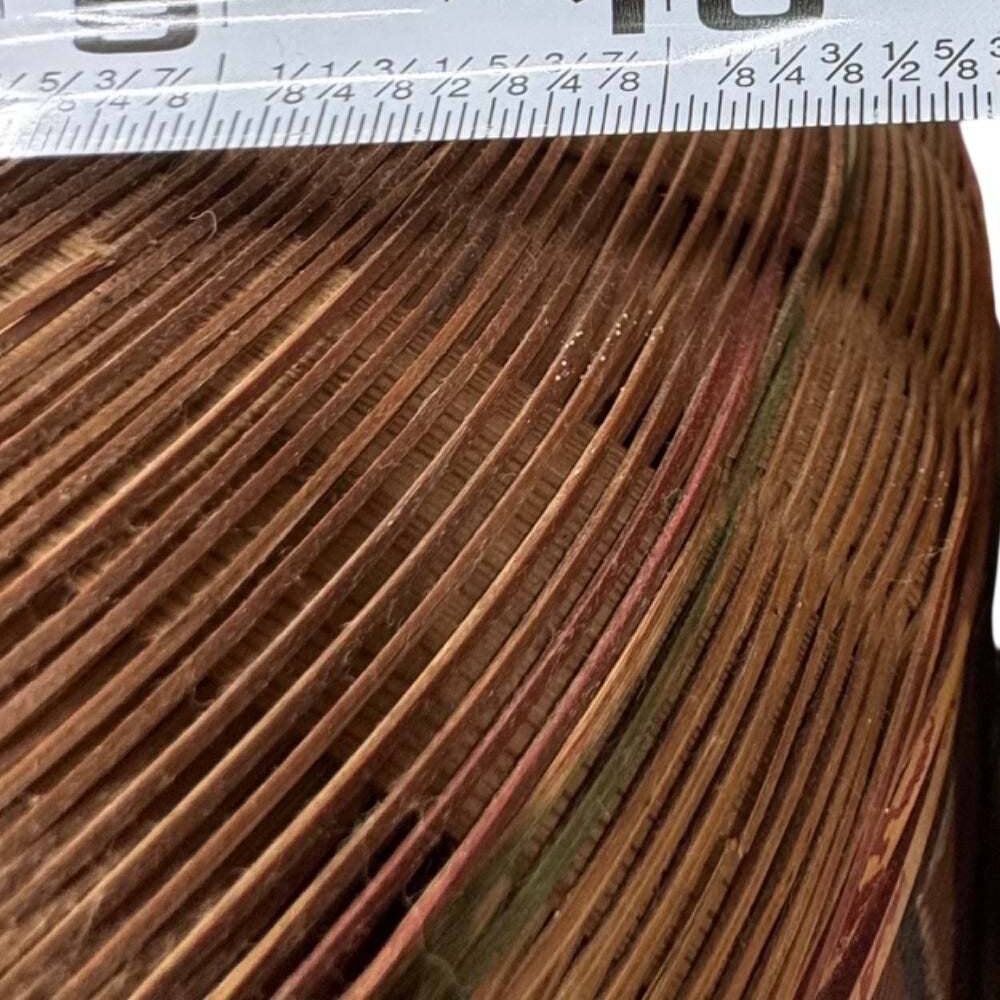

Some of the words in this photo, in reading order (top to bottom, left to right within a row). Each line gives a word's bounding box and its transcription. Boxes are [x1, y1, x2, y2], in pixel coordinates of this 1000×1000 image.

[820, 42, 863, 84] 3/8
[881, 40, 920, 81] 1/2
[933, 37, 979, 80] 5/8
